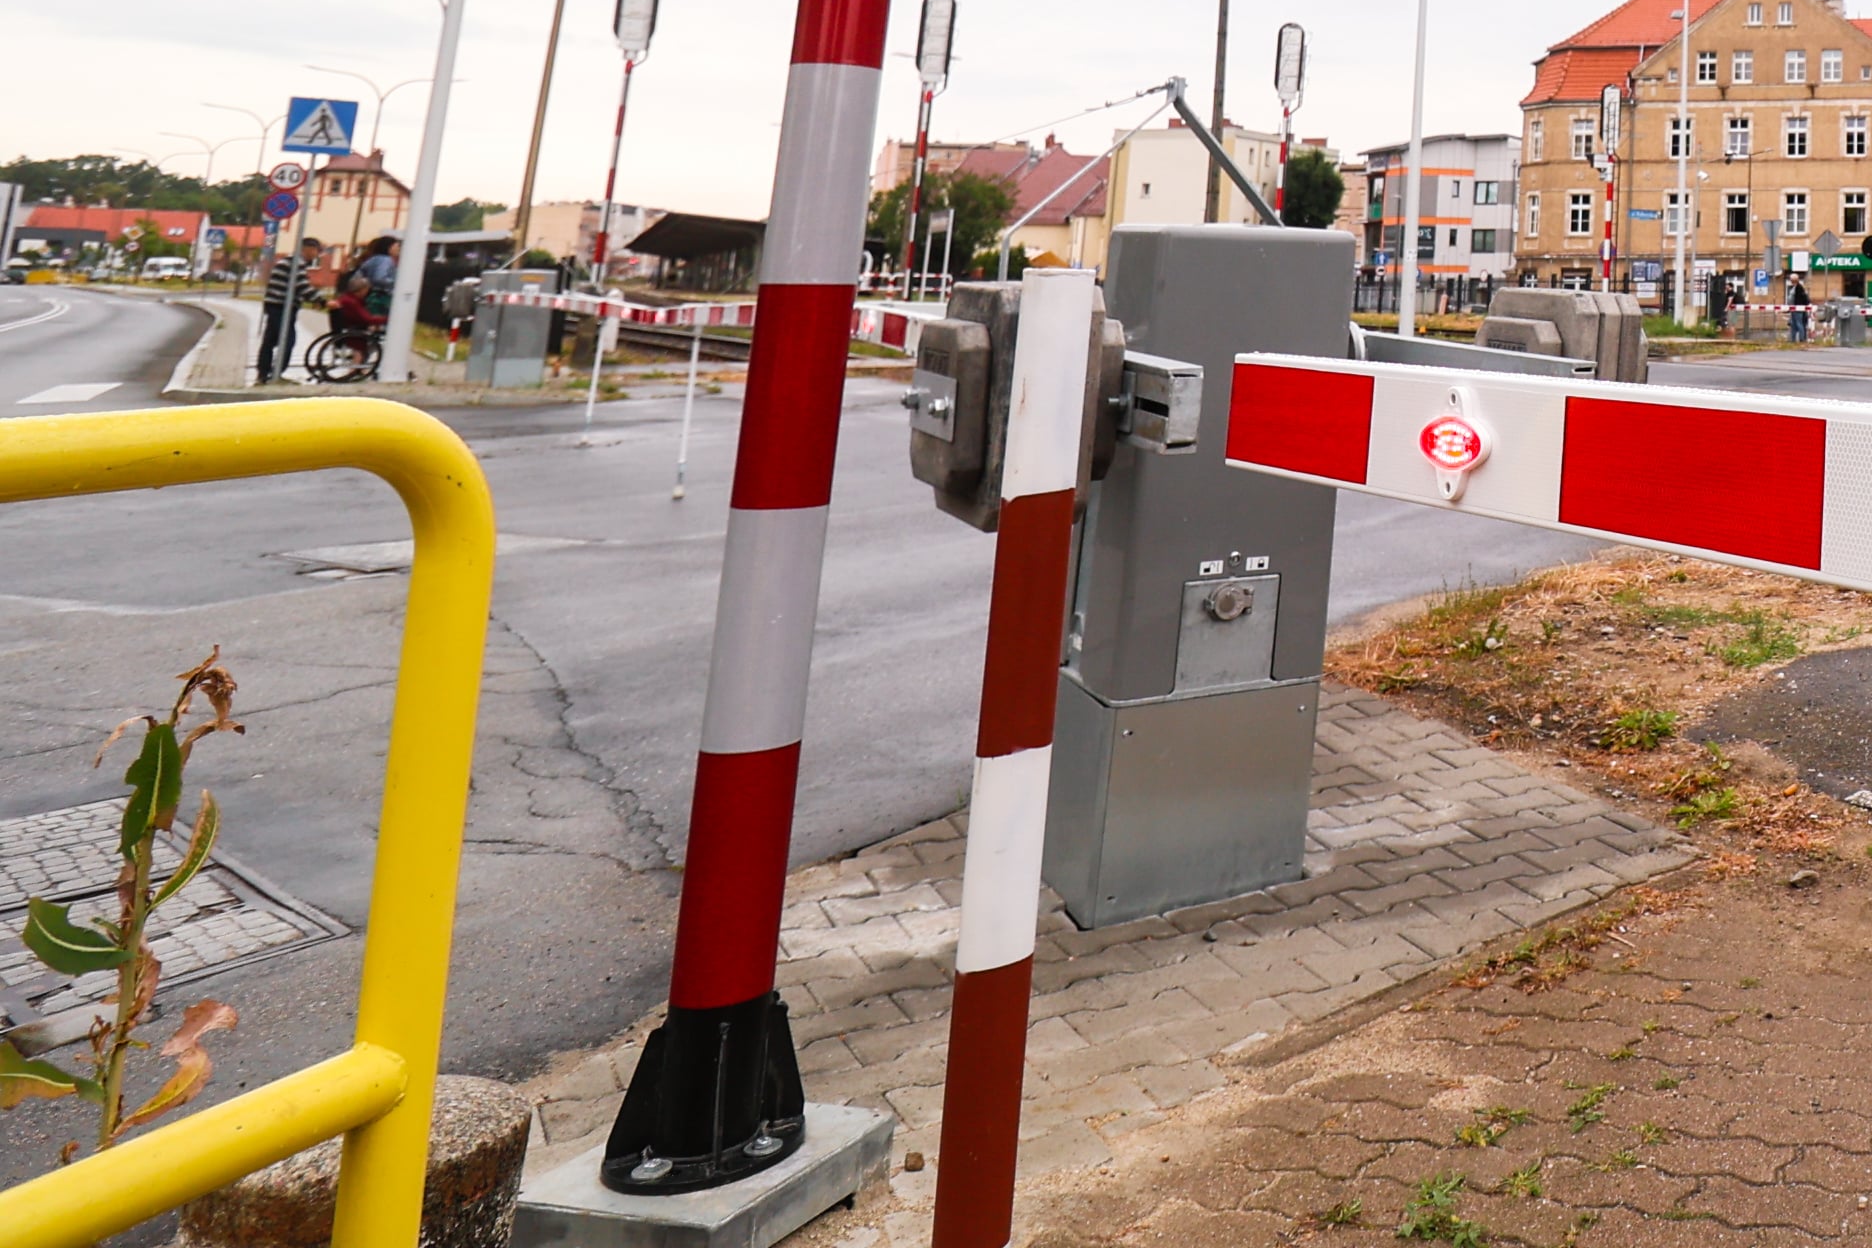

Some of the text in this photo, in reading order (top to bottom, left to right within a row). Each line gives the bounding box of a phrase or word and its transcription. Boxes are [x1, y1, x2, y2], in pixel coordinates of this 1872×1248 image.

[274, 170, 300, 183] 40
[1815, 257, 1861, 266] APTEKA
[1757, 271, 1766, 282] P
